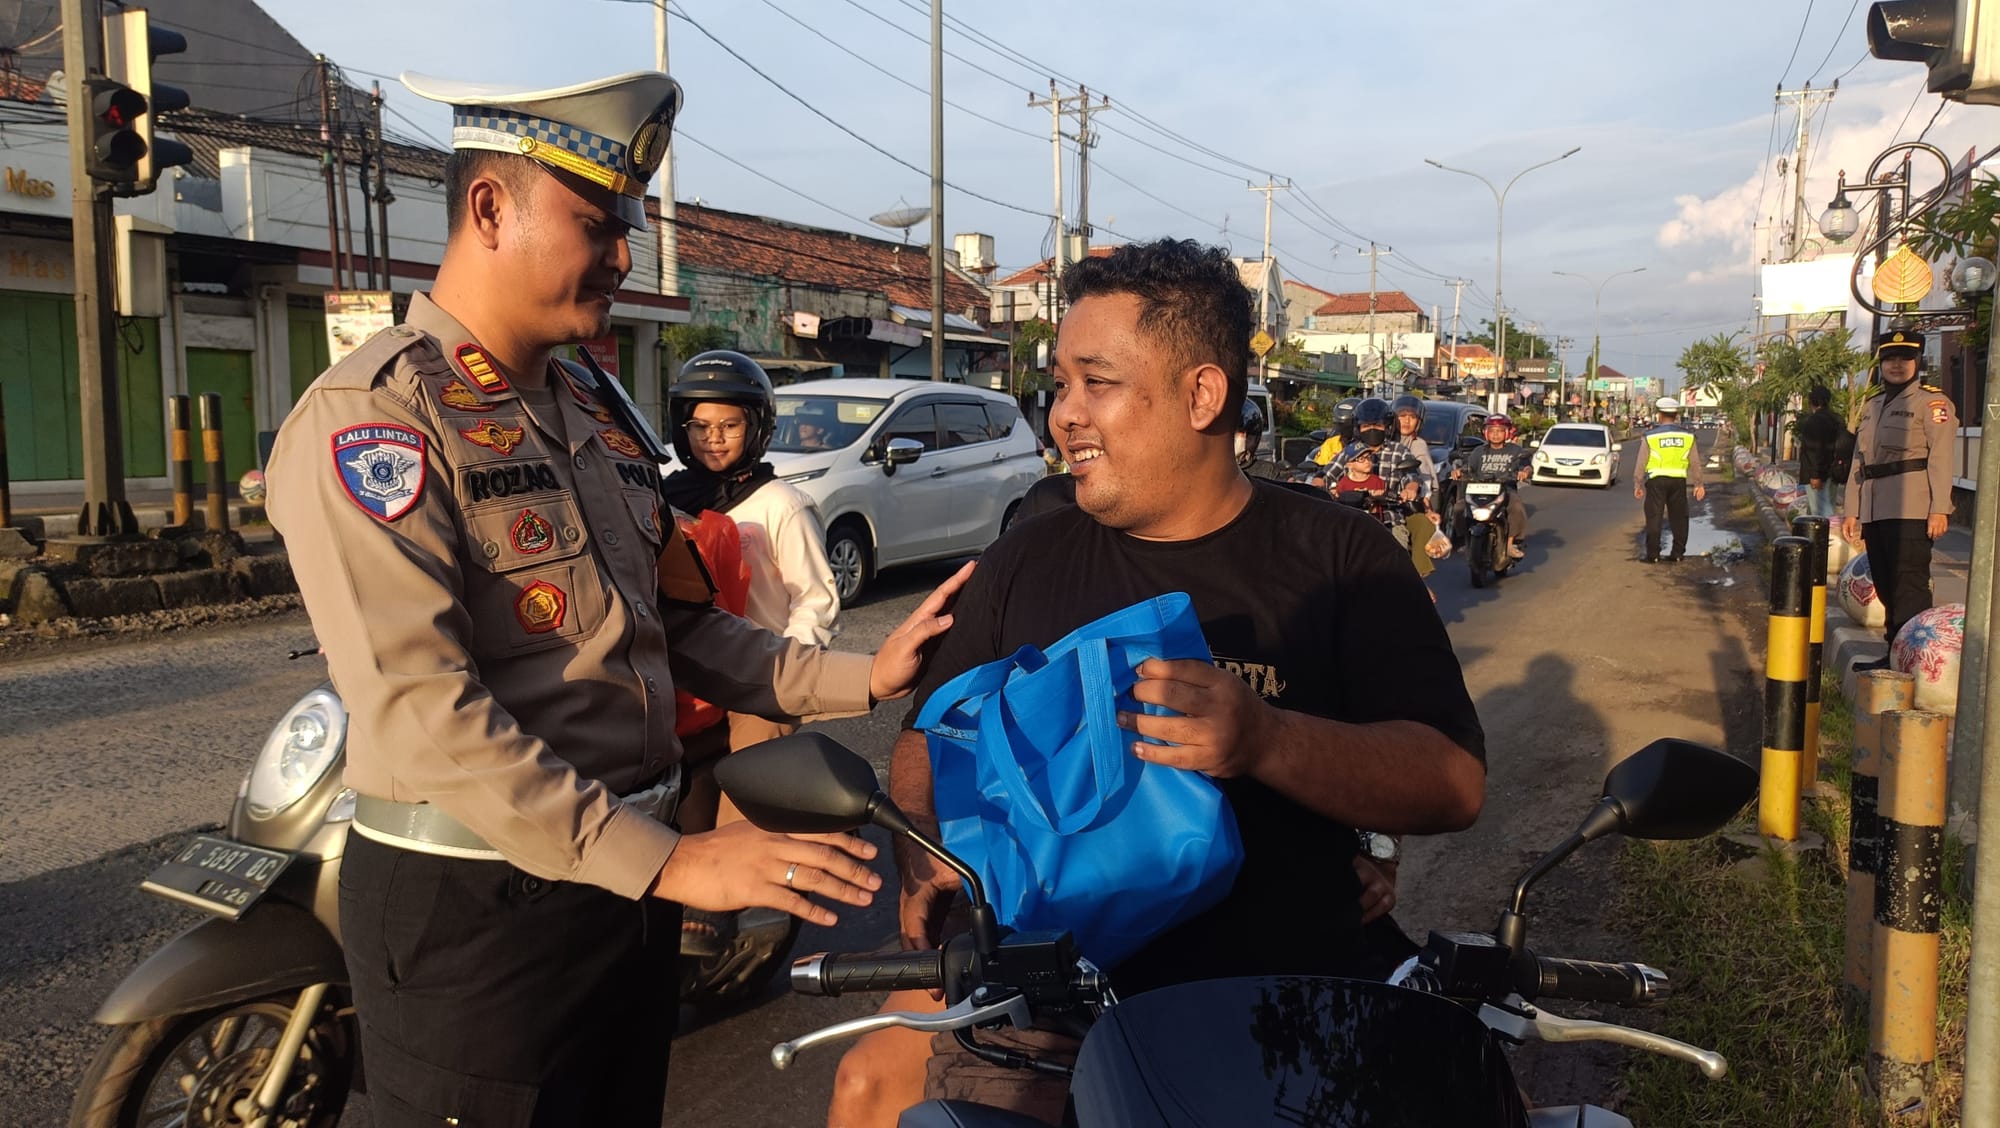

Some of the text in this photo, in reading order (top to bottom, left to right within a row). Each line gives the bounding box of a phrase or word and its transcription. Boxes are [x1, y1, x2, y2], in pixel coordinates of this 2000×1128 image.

[5, 166, 56, 199] Mas
[338, 428, 417, 445] LALU LINTAS
[200, 846, 251, 872] 5897
